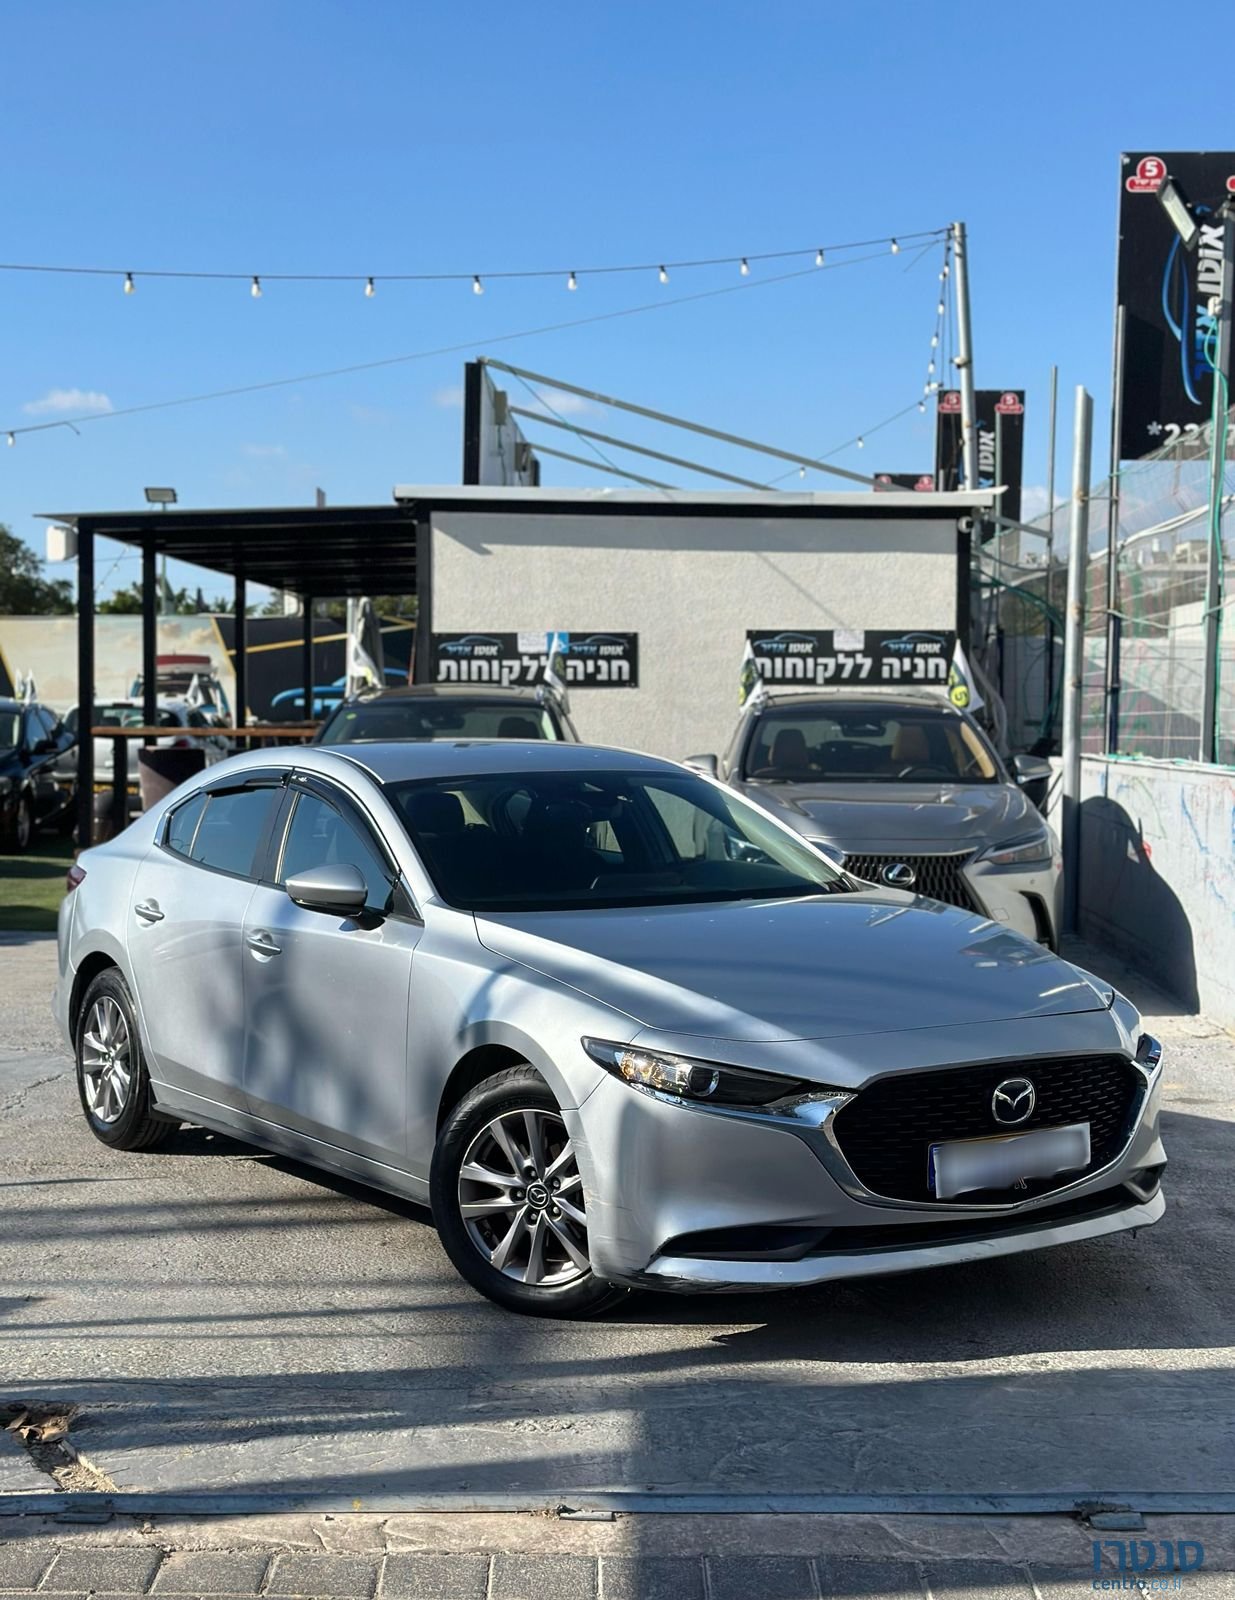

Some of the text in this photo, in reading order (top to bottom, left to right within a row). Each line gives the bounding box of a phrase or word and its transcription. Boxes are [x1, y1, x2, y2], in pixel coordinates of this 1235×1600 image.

[1144, 161, 1159, 177] 5
[1196, 222, 1226, 294] אוטו
[565, 658, 631, 682] חניה
[755, 653, 947, 685] חניה ללקוחות
